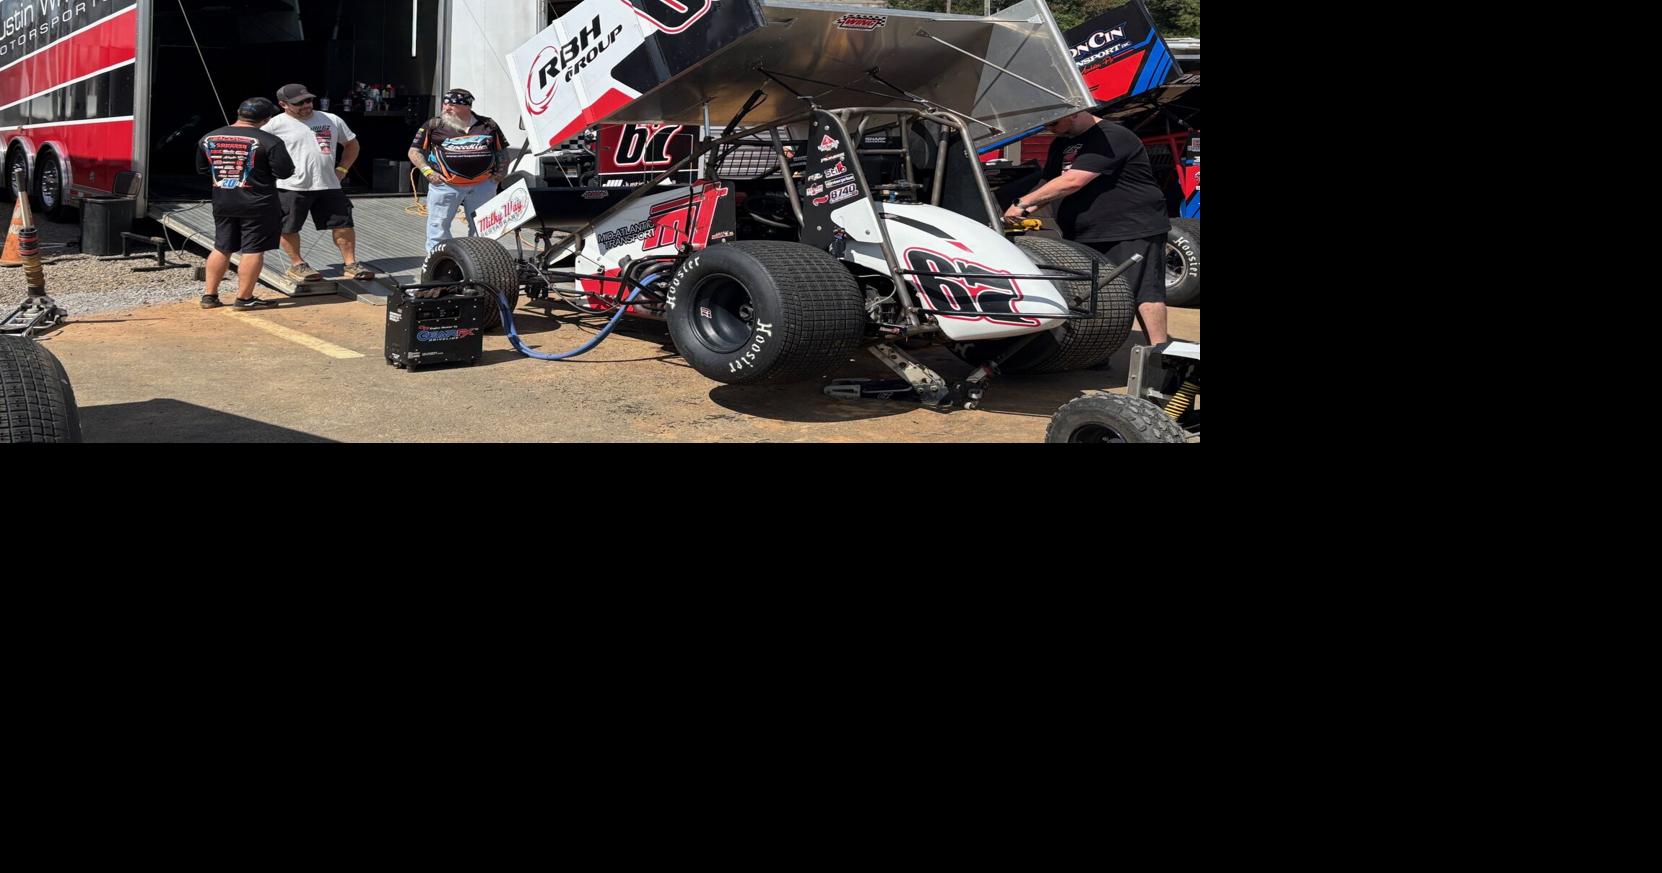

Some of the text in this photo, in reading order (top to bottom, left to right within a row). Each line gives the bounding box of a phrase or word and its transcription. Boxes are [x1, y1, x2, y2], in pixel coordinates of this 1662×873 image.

[538, 14, 602, 90] RBH
[564, 24, 623, 83] GROUP
[478, 210, 503, 233] Milky
[598, 219, 655, 244] MID-ATLANTIC
[603, 229, 656, 250] TRANSPORT
[666, 256, 700, 310] Hoosier
[1173, 236, 1199, 278] Hoosier
[903, 246, 1041, 328] 67
[728, 318, 773, 373] Hoosier
